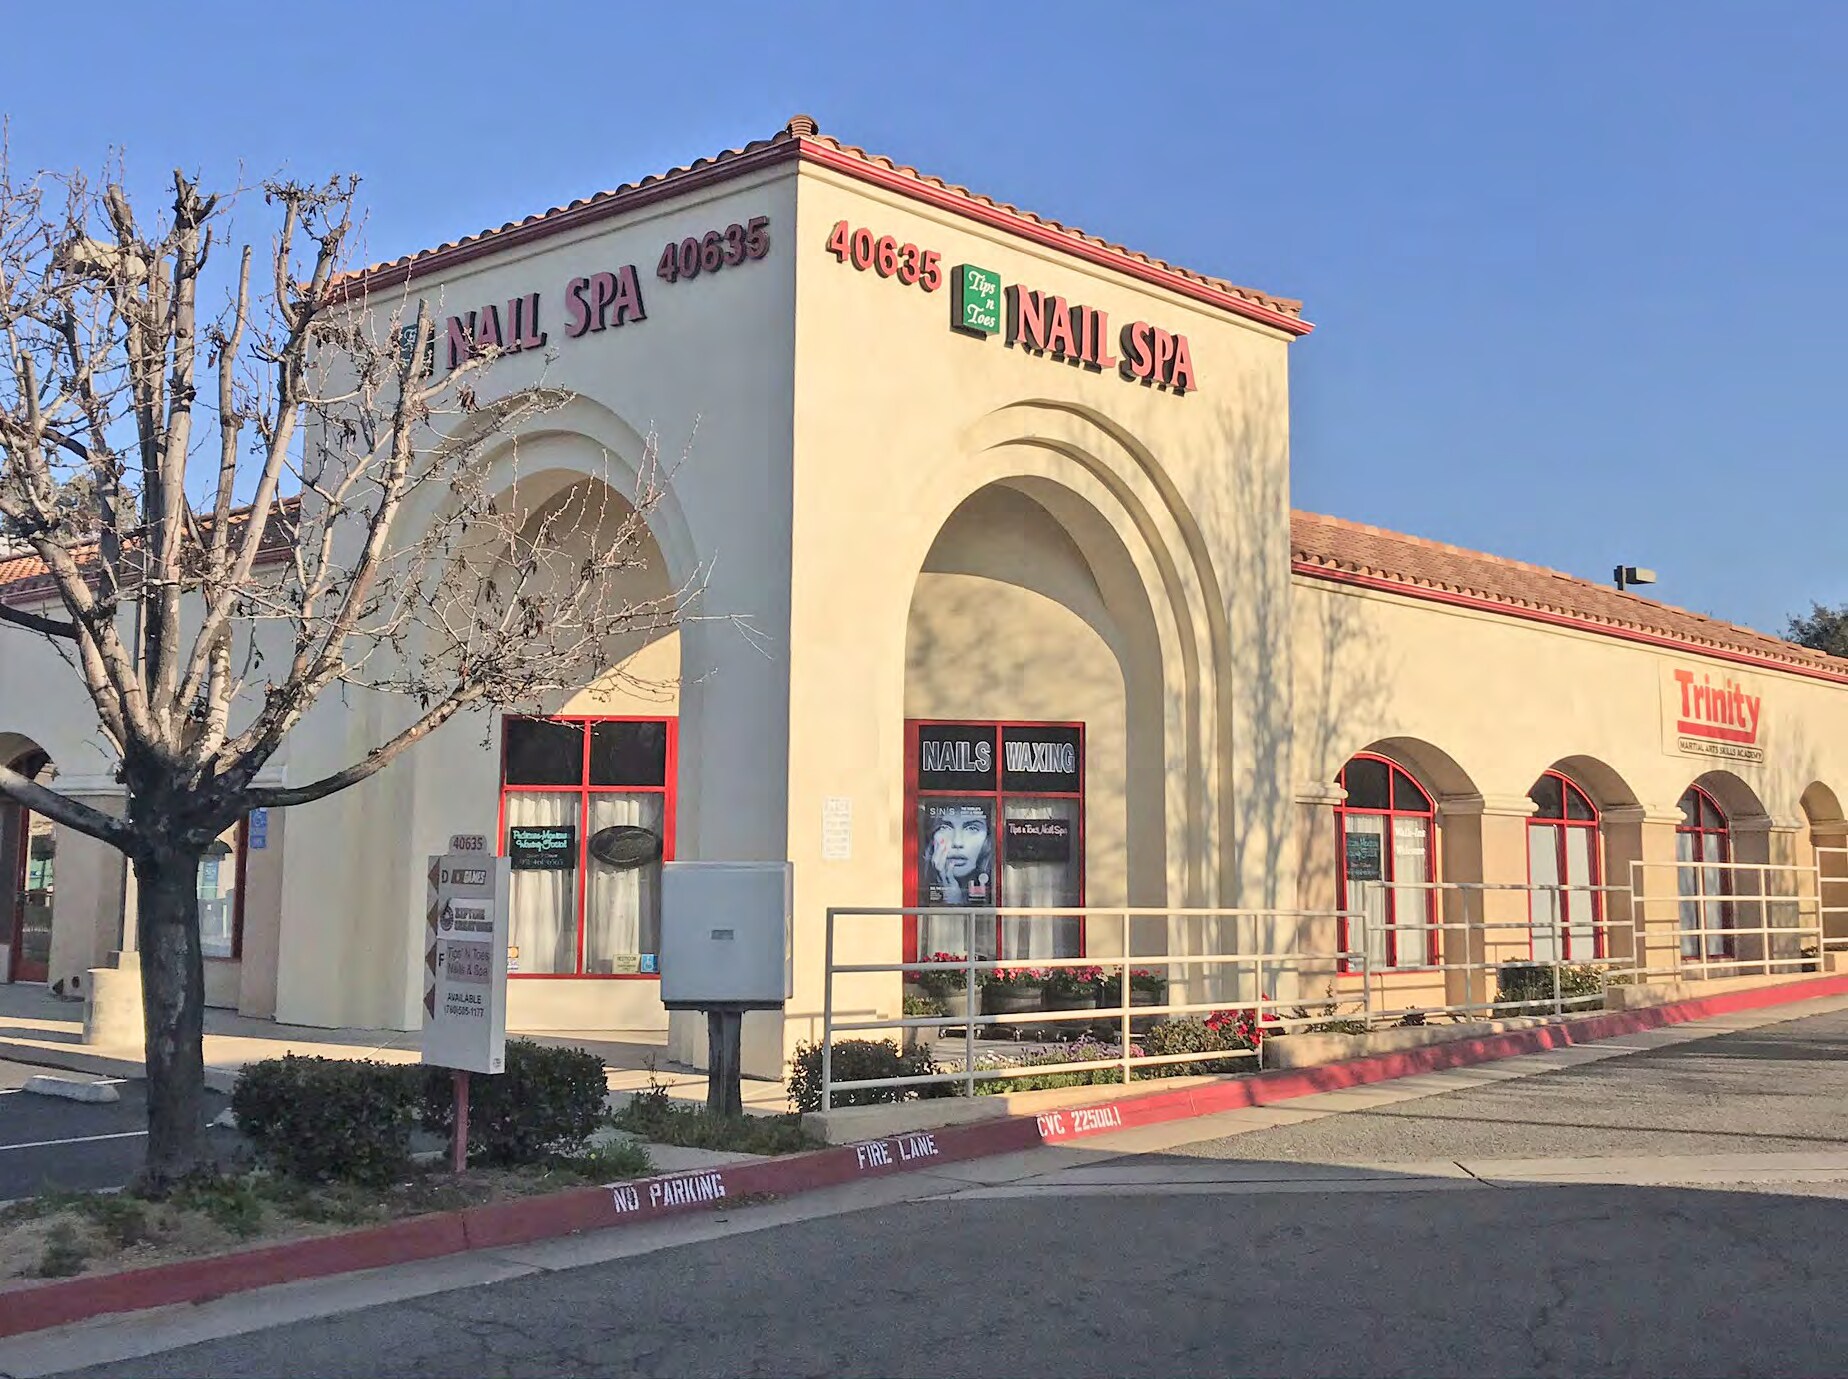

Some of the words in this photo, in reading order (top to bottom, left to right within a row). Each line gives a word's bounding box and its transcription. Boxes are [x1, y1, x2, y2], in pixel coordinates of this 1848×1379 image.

[656, 215, 770, 283] 40635
[826, 219, 942, 292] 40635
[968, 270, 996, 297] Tips
[446, 293, 547, 369] NAIL
[564, 264, 647, 338] SPA
[967, 303, 996, 327] Toes
[985, 298, 995, 310] n
[1004, 284, 1117, 374] NAIL
[1120, 320, 1197, 397] SPA
[1674, 668, 1760, 744] Trinity
[922, 741, 992, 772] NAILS
[1005, 741, 1076, 774] WAXING
[1680, 741, 1704, 752] MARTIAL
[1705, 745, 1719, 754] ARTS
[1719, 747, 1736, 757] SKILLS
[1737, 749, 1762, 759] ACADEMY
[453, 836, 483, 850] 40635
[1054, 825, 1068, 837] Spa
[441, 869, 449, 883] D
[438, 953, 445, 967] F
[473, 947, 490, 961] Toes
[447, 962, 465, 976] Nails
[466, 964, 472, 976] &
[474, 964, 489, 976] Spa
[447, 992, 482, 1004] AVAILABLE
[1036, 1113, 1066, 1138] CVC
[1070, 1106, 1122, 1133] 22500.1
[856, 1140, 893, 1170] FIRE
[898, 1134, 939, 1161] LANE
[613, 1186, 639, 1214] NO
[649, 1173, 726, 1208] PARKING
